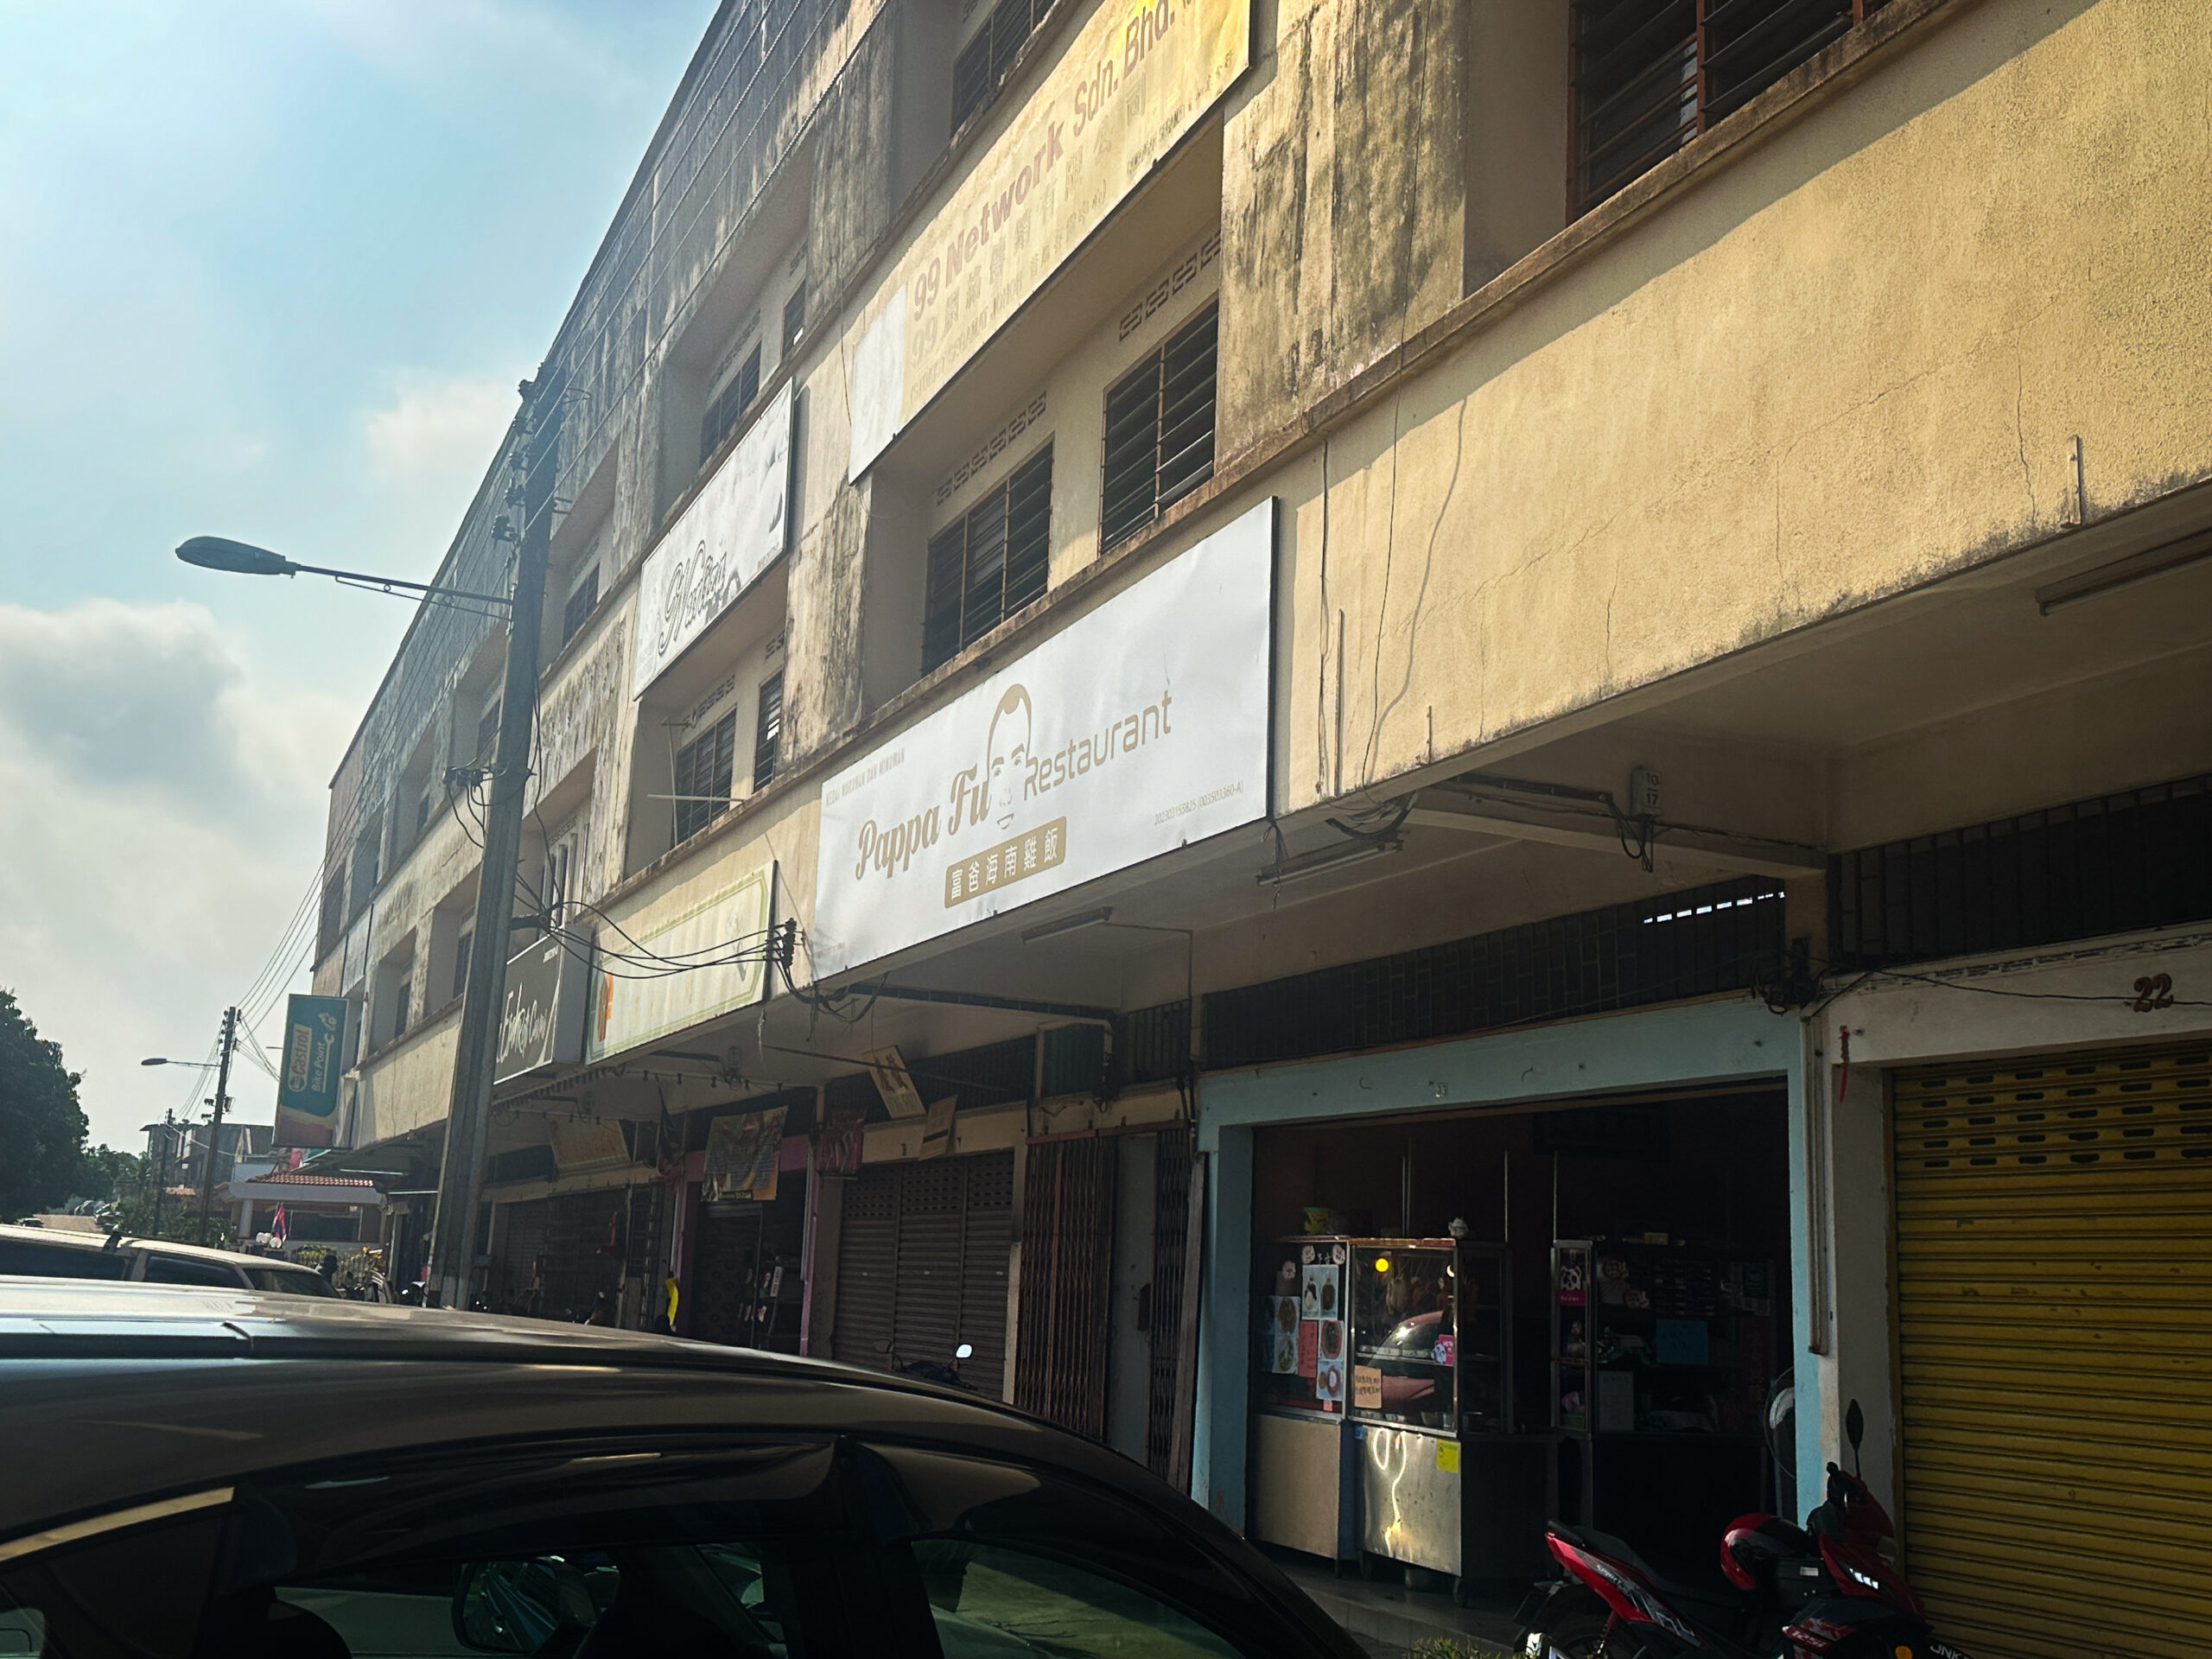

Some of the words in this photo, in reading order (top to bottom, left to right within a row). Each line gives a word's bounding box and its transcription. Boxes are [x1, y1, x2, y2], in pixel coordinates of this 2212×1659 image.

[914, 257, 941, 322] 99
[945, 118, 1066, 289] Network
[1072, 60, 1119, 139] Sdn.
[1124, 0, 1175, 79] Bhd.
[842, 771, 866, 797] MAKANAN
[867, 763, 878, 784] DAN
[879, 747, 906, 773] MINUMAN
[855, 807, 941, 880] Pappa
[947, 765, 994, 836] Fu
[1024, 689, 1173, 802] Restaurant
[951, 827, 1058, 900] 富爸海南雞飯
[2133, 973, 2173, 1013] 22
[291, 1027, 310, 1076] Castrol
[315, 1041, 327, 1069] Point
[312, 1071, 323, 1093] Bike
